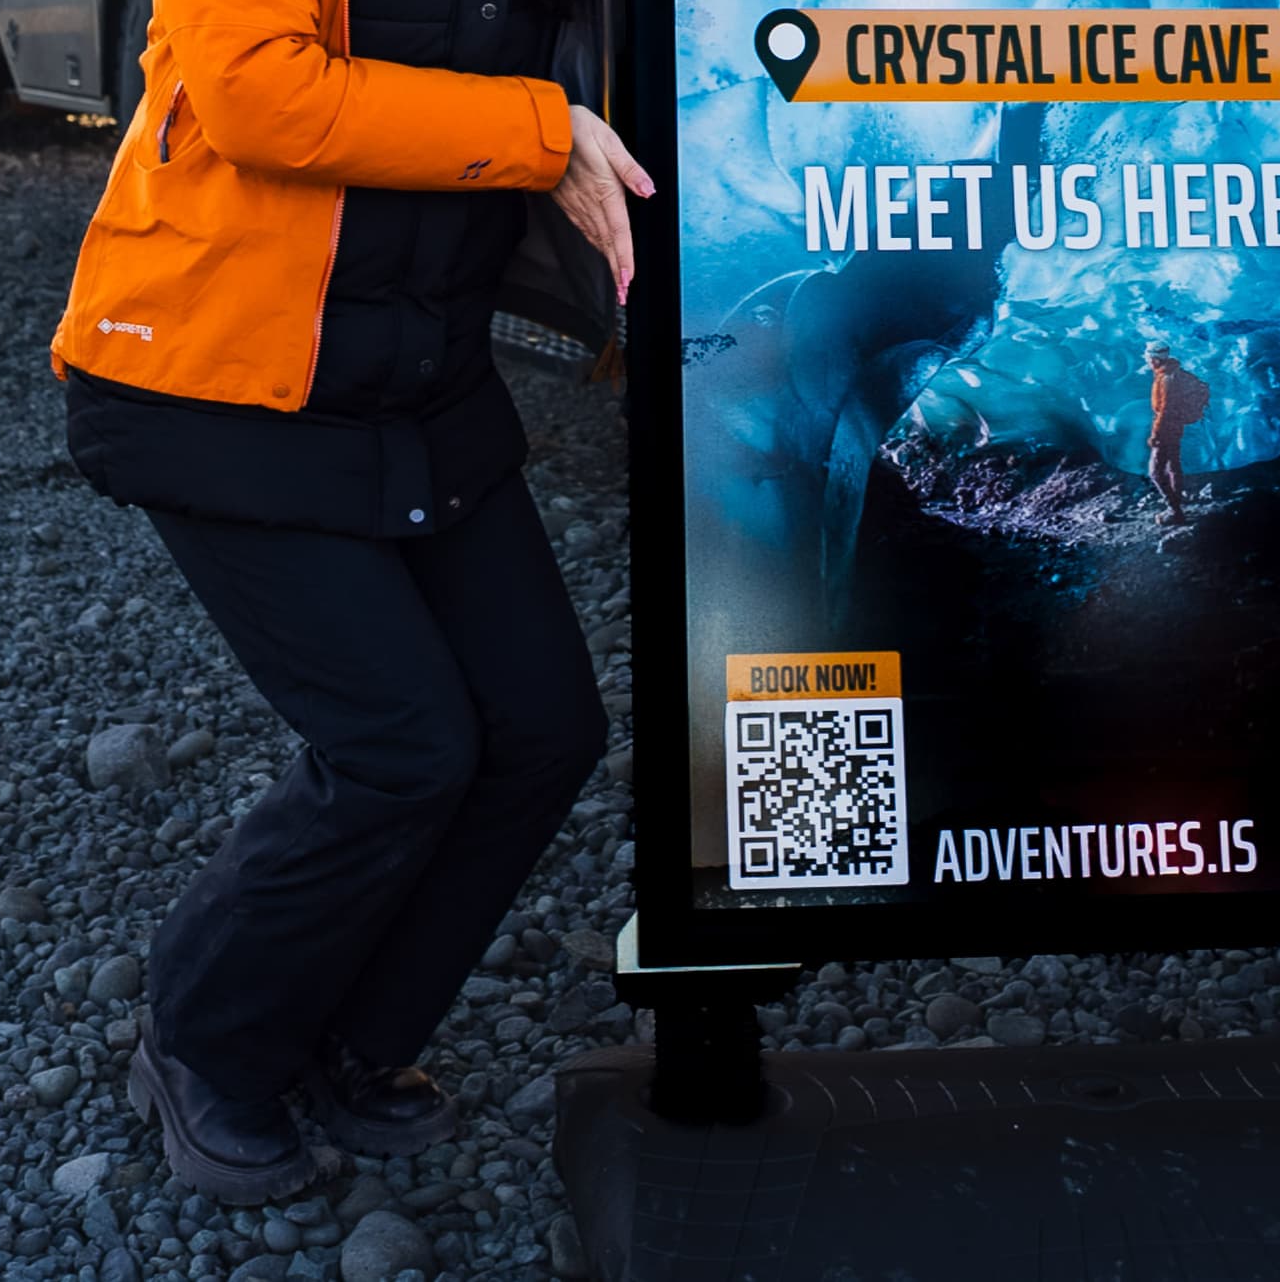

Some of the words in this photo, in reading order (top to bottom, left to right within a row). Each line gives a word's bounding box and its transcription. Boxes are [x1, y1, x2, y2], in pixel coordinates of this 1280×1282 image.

[846, 23, 1055, 86] CRYSTAL
[1069, 24, 1139, 84] ICE
[1153, 24, 1272, 84] CAVE
[803, 164, 994, 252] MEET
[1011, 163, 1100, 251] US
[751, 665, 811, 694] BOOK
[815, 662, 877, 692] NOW!
[933, 818, 1258, 884] ADVENTURES.IS
